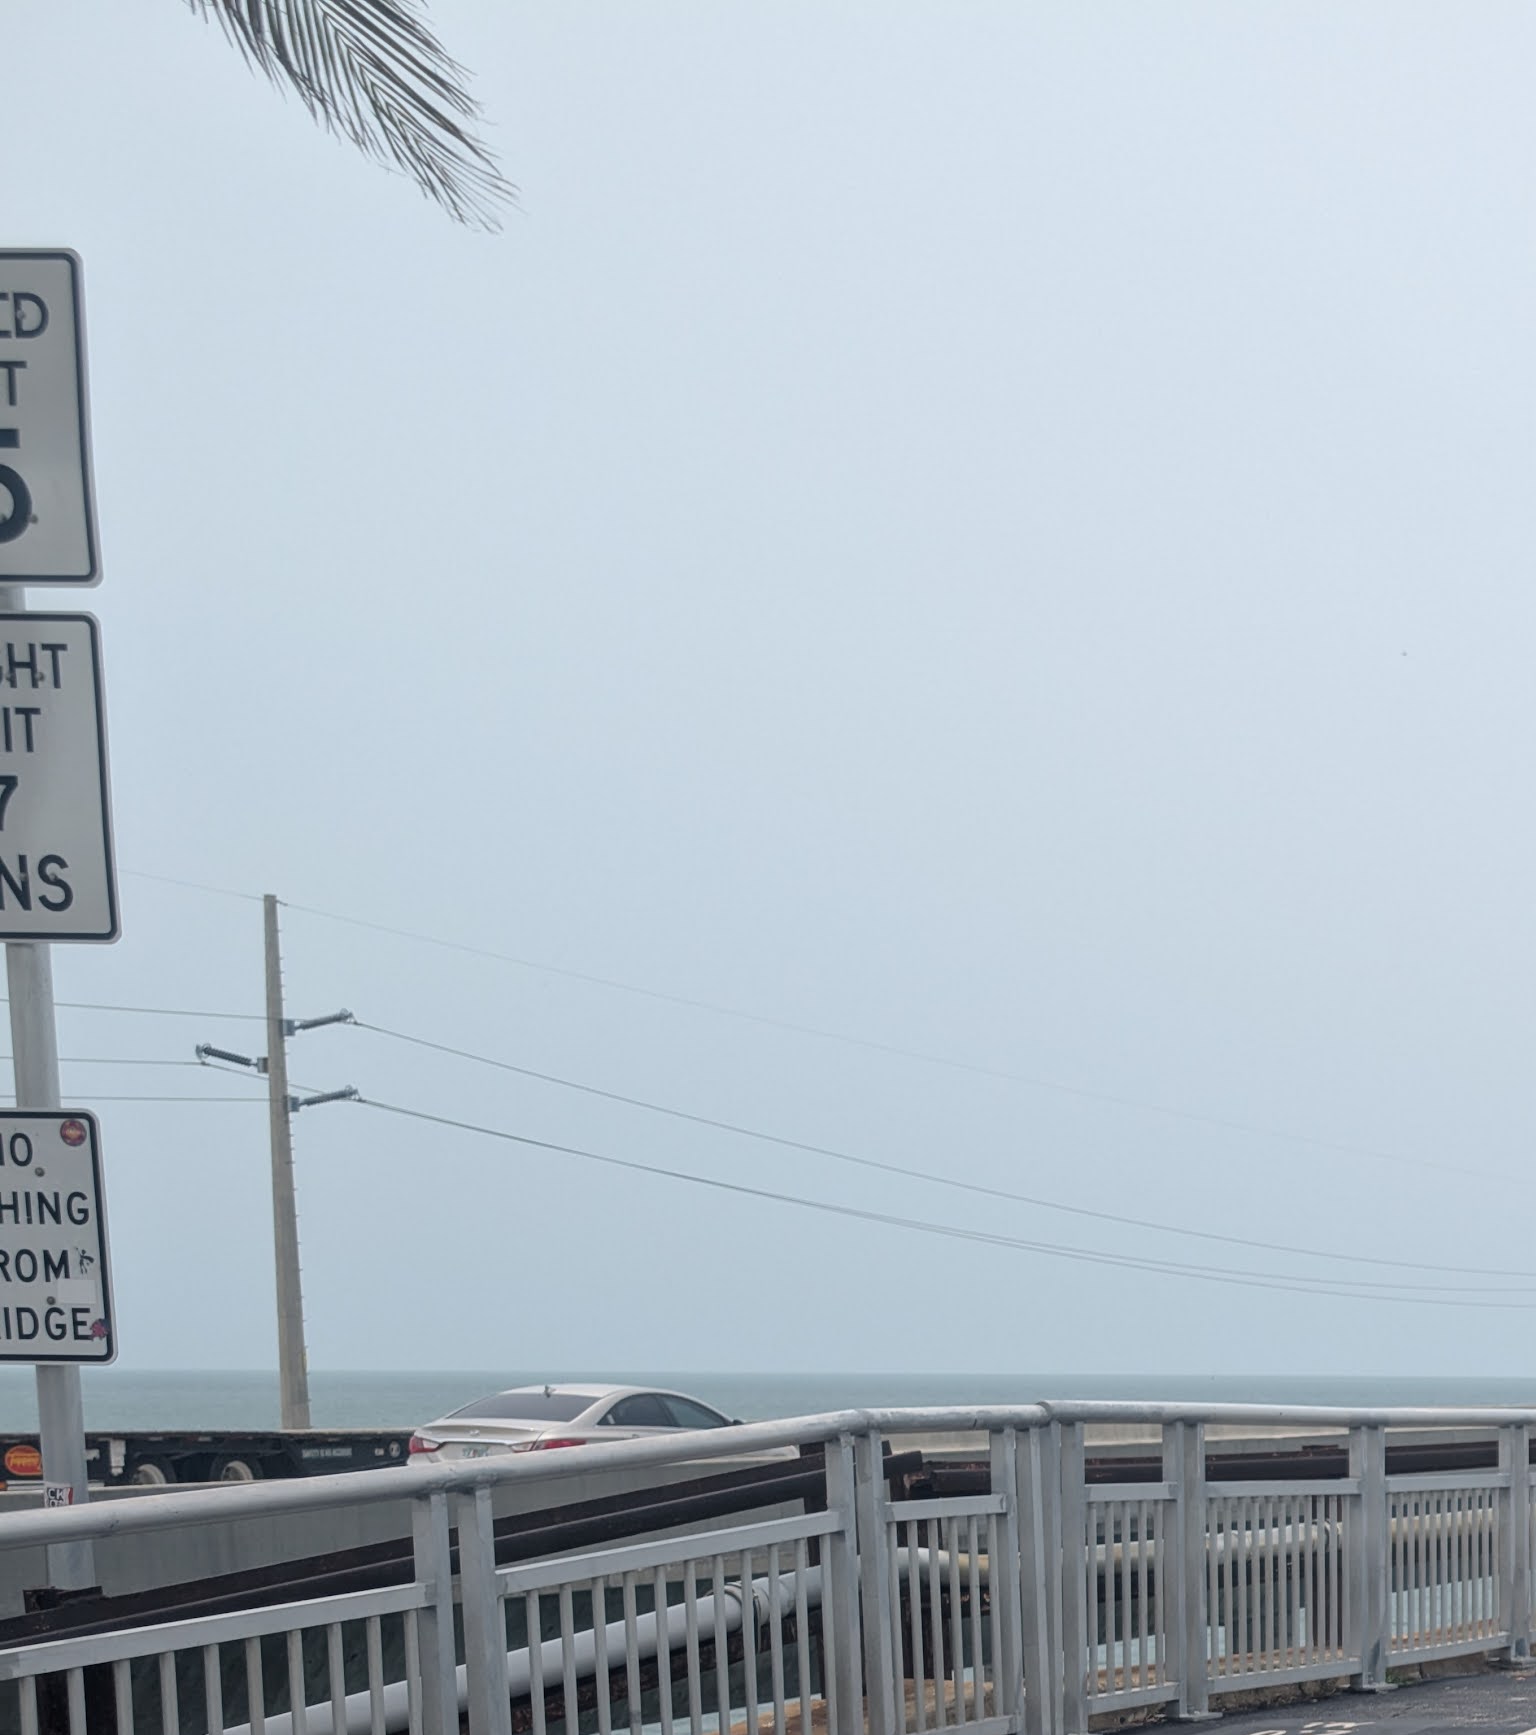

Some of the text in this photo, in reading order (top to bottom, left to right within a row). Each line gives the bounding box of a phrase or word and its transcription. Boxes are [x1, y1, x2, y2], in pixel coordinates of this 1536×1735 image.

[0, 643, 68, 689] HT
[0, 1132, 33, 1168] O
[0, 1307, 91, 1341] IDGE
